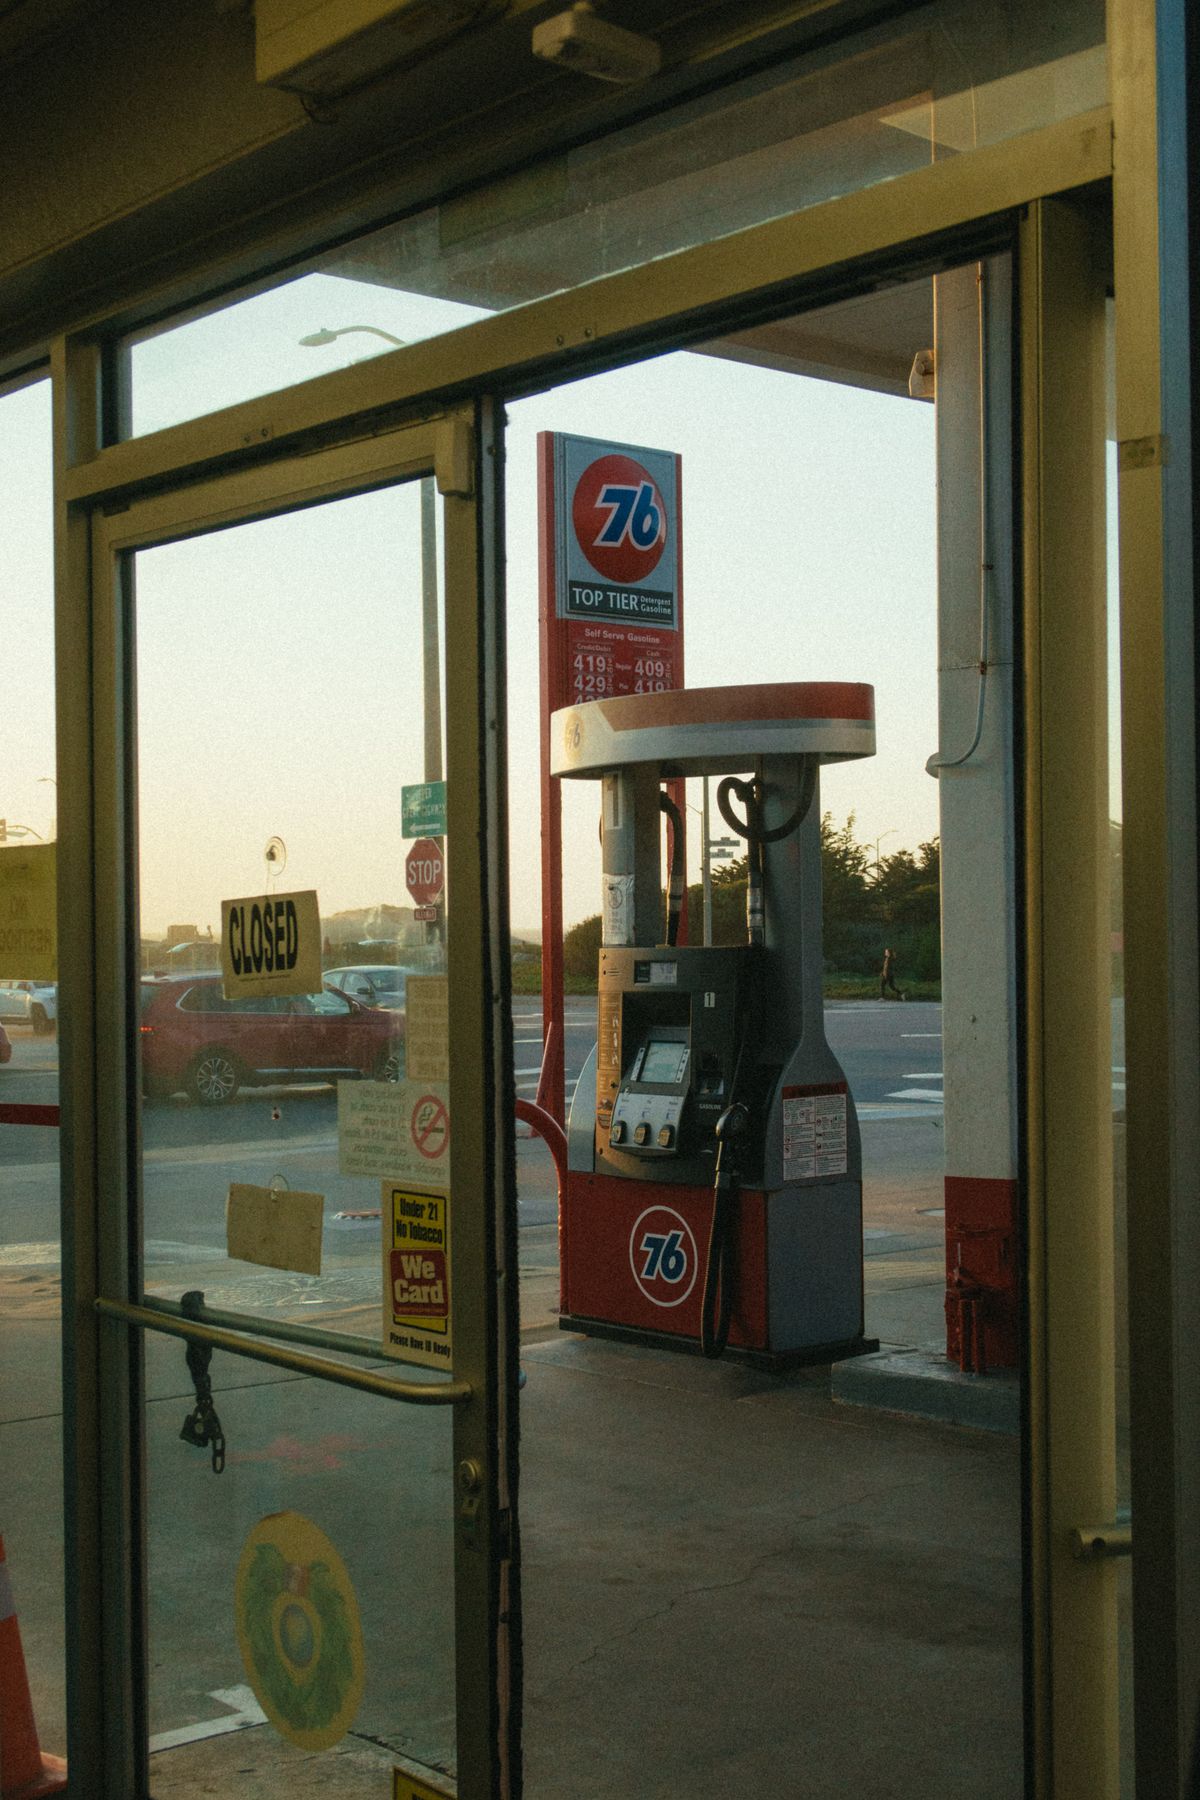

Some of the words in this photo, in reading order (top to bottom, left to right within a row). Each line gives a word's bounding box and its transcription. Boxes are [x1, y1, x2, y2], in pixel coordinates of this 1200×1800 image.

[592, 480, 661, 551] 76
[572, 588, 603, 606] TOP
[606, 592, 639, 611] TIER
[640, 596, 671, 605] Detergent
[640, 603, 672, 615] Gasoline
[584, 628, 601, 638] Self
[603, 630, 625, 641] Serve
[627, 632, 660, 644] Gasoline
[574, 655, 606, 673] 419
[634, 660, 665, 678] 409
[574, 674, 606, 692] 429
[408, 860, 441, 885] STOP
[229, 900, 299, 976] CLOSED
[400, 1198, 426, 1218] Under
[428, 1202, 438, 1221] 21
[396, 1219, 407, 1238] No
[408, 1221, 443, 1244] Tobacco
[400, 1255, 436, 1280] We
[640, 1229, 687, 1284] 76
[394, 1278, 445, 1304] Card
[390, 1332, 409, 1347] Please
[433, 1341, 451, 1359] Ready
